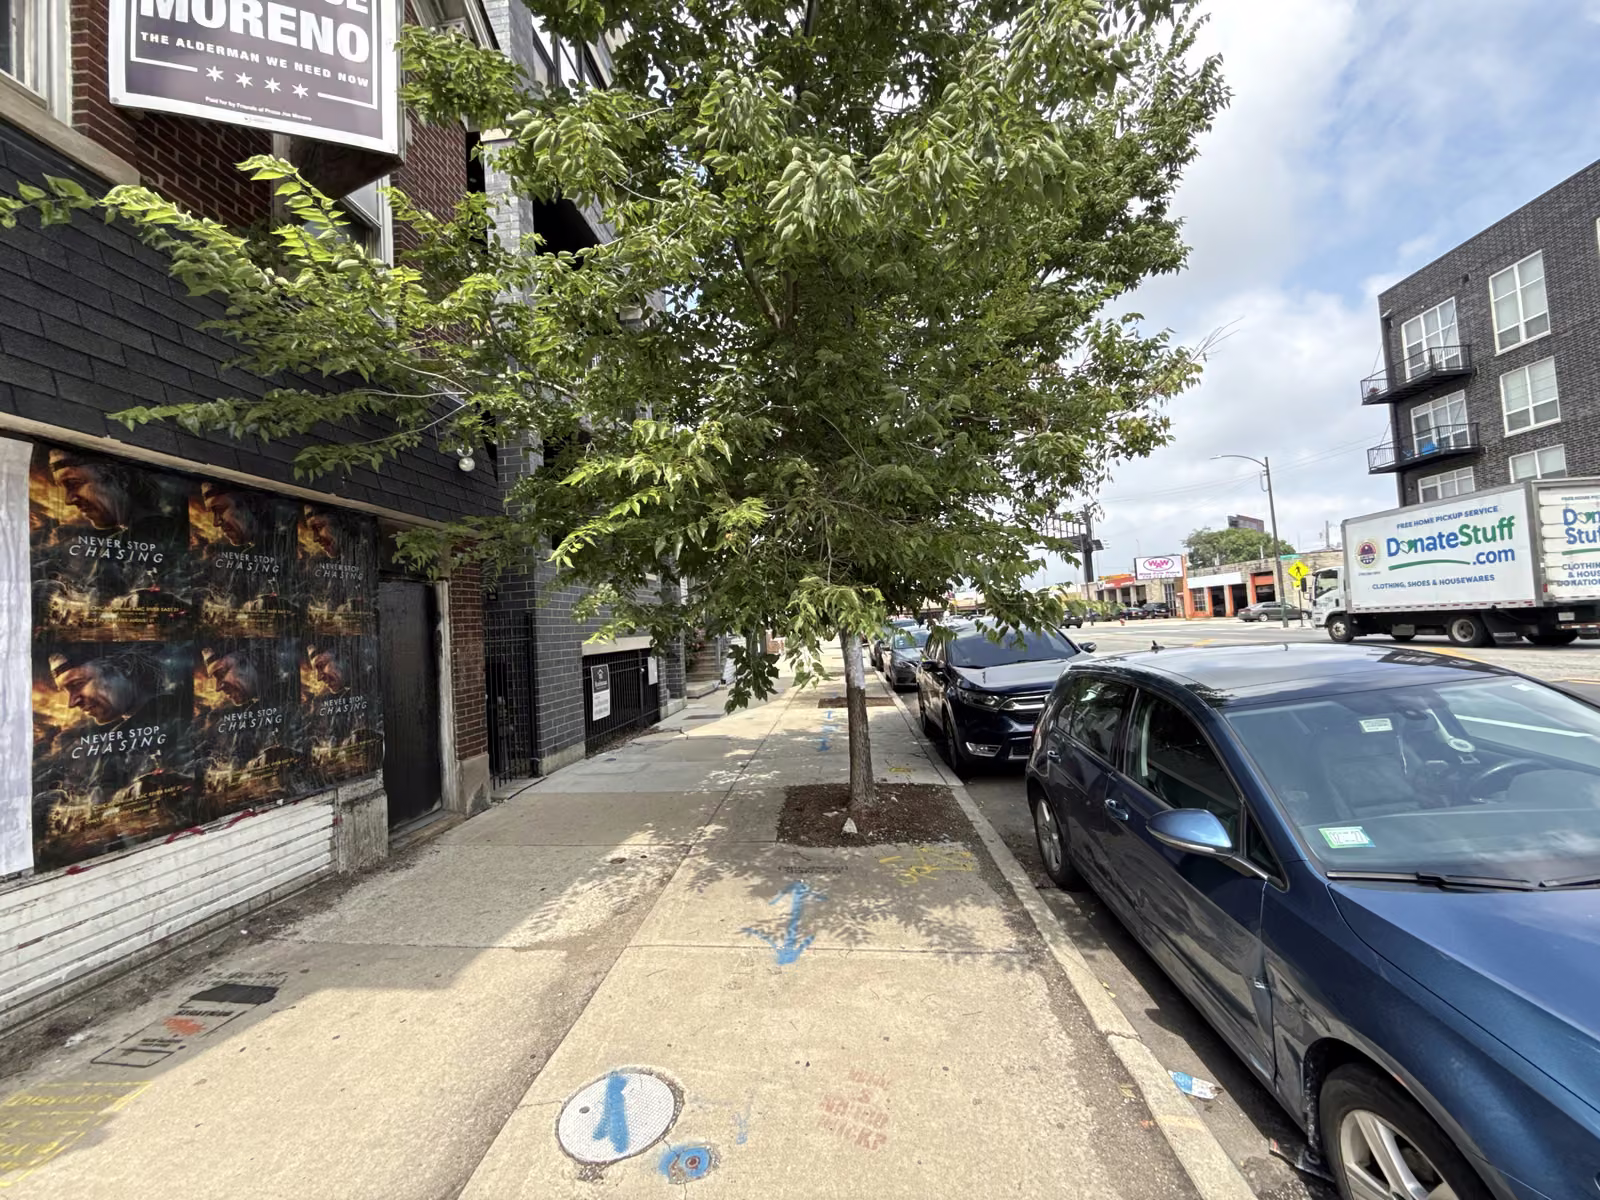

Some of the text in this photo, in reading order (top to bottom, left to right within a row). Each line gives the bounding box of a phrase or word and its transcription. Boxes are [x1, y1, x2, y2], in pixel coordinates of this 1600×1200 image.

[140, 0, 370, 63] MORENO
[140, 31, 369, 88] THE ALDERMAN WE NEED NOW
[1396, 505, 1499, 529] FREE HOME PICKUP SERVICE
[78, 535, 156, 551] NEVER STOP
[69, 544, 164, 563] CHASING
[221, 551, 275, 564] NEVER STOP
[1472, 548, 1516, 565] .com
[215, 558, 280, 573] CHASING
[320, 562, 344, 571] NEVER
[314, 569, 364, 580] CHASING
[1372, 580, 1407, 590] CLOTHING,
[1407, 579, 1431, 588] SHOES
[1440, 574, 1495, 585] HOUSEWARES
[1557, 579, 1600, 587] DONATIO
[223, 707, 277, 722] NEVER STOP
[319, 701, 368, 716] CHASING
[218, 714, 283, 733] CHASING
[80, 725, 160, 745] NEVER STOP
[71, 734, 167, 759] CHASING
